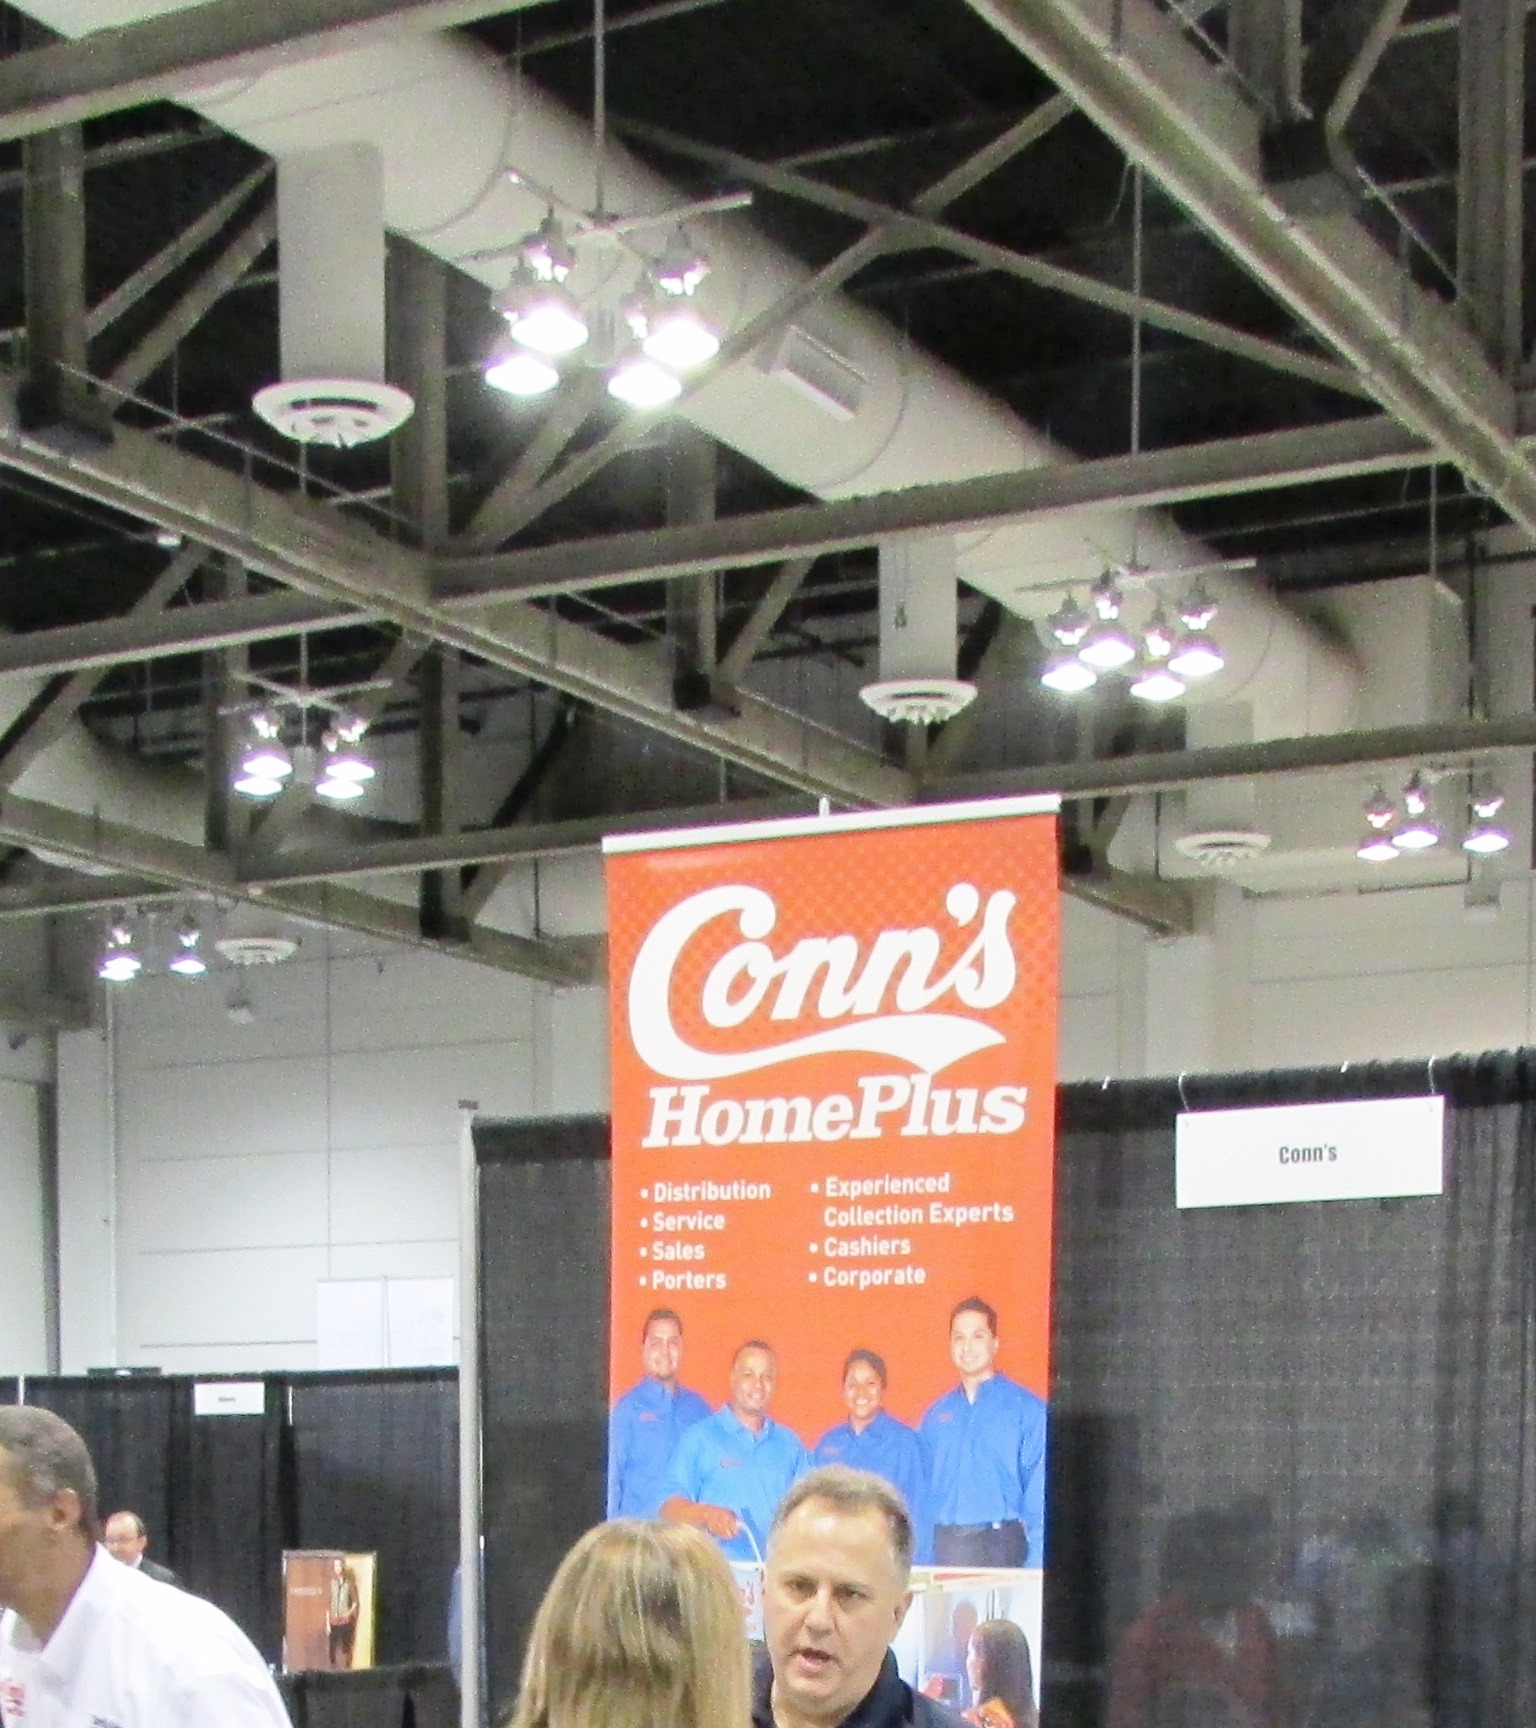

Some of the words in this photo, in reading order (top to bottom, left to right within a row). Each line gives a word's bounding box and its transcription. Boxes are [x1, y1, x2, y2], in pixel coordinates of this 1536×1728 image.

[629, 882, 1017, 1080] Conn's
[642, 1072, 1028, 1148] HomePlus
[1279, 1143, 1338, 1164] Conn's
[654, 1180, 772, 1202] Distribution
[825, 1172, 951, 1200] Experienced
[652, 1212, 726, 1232] Service
[823, 1205, 924, 1227] Collection
[929, 1201, 1015, 1228] Experts
[652, 1242, 706, 1261] Sales
[823, 1238, 912, 1259] Cashiers
[652, 1270, 727, 1291] Porters
[823, 1266, 926, 1291] Corporate
